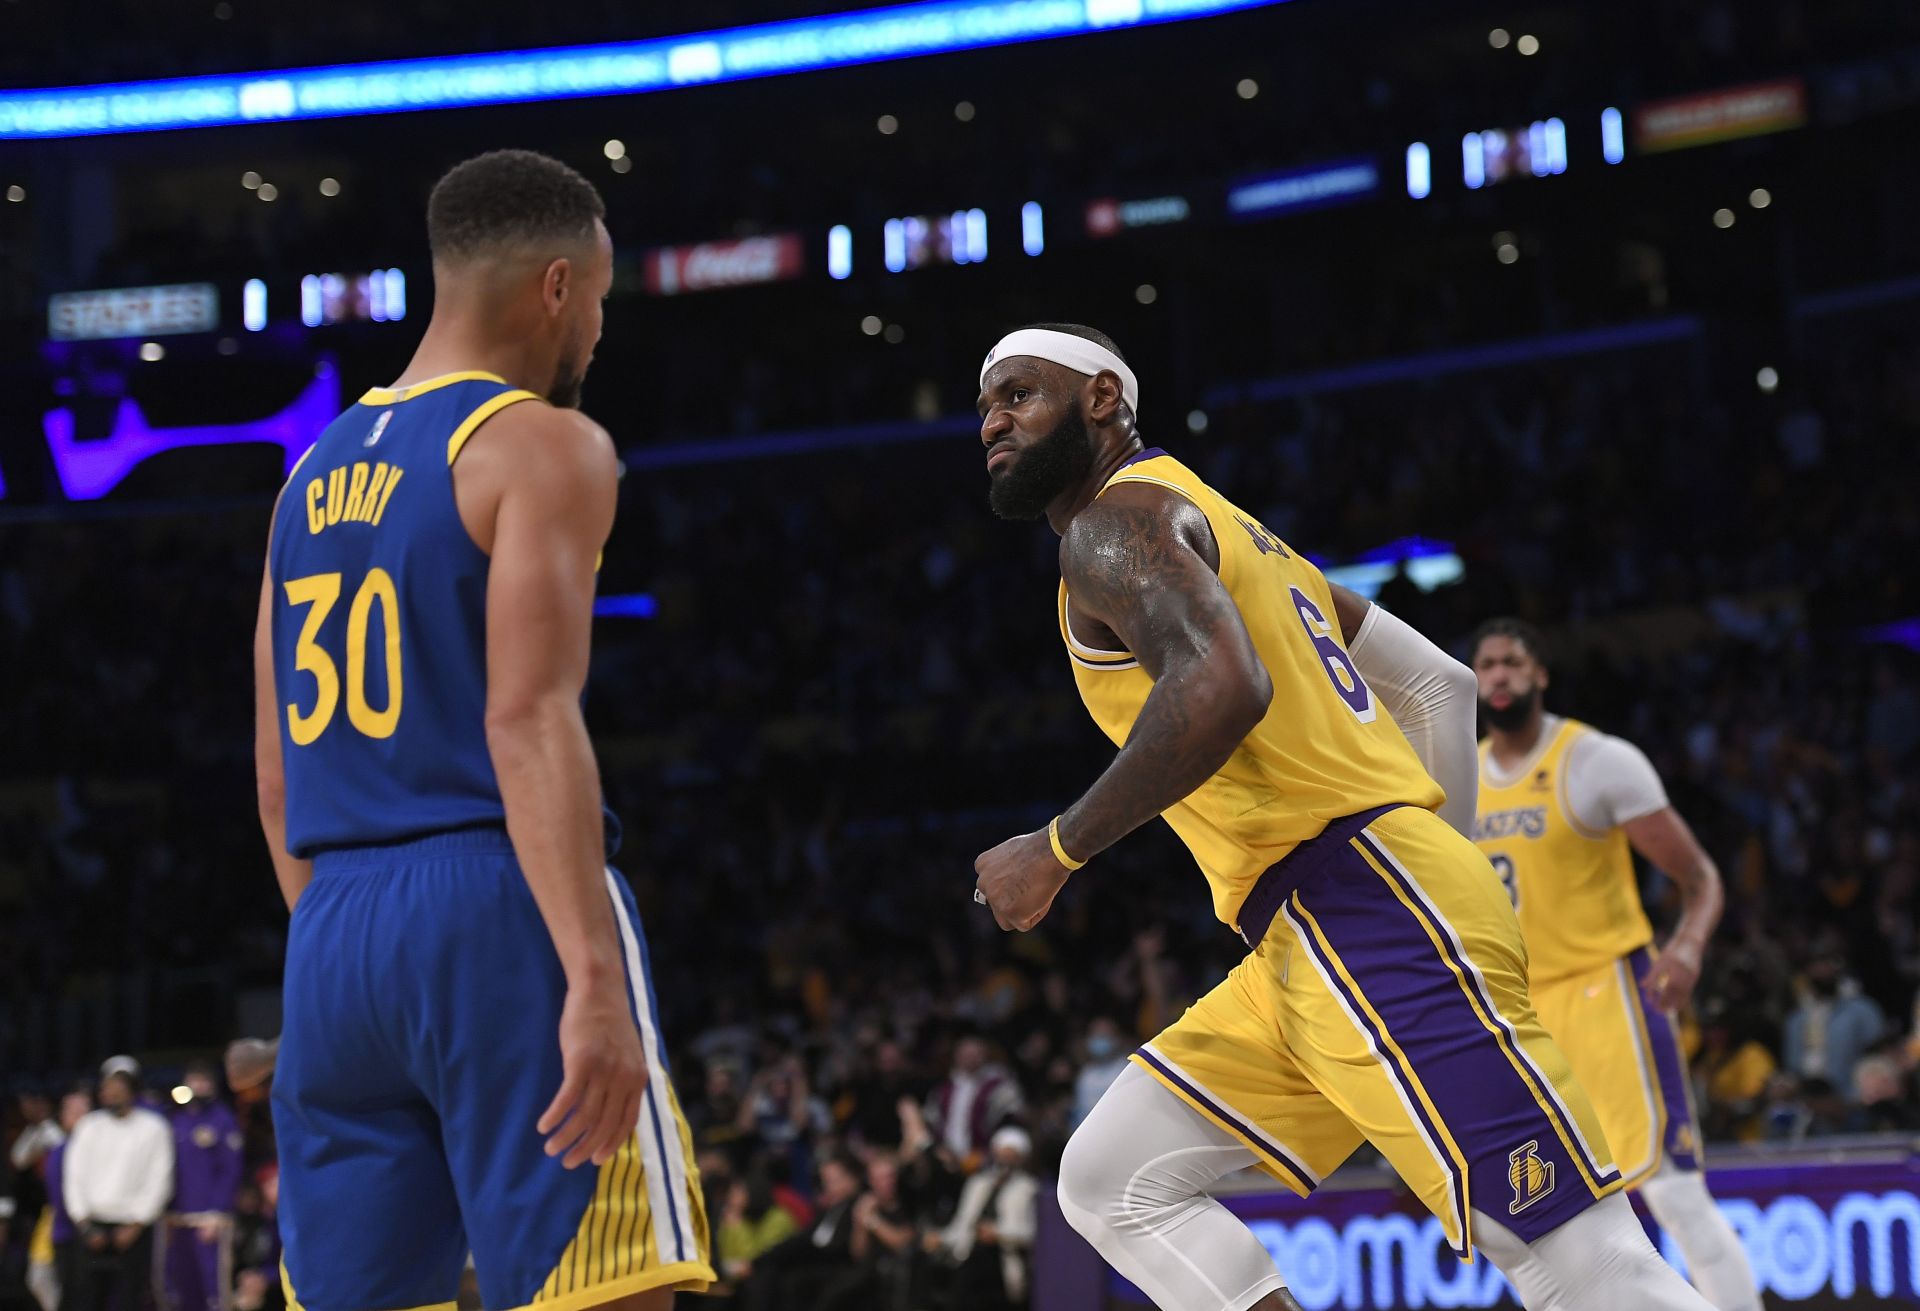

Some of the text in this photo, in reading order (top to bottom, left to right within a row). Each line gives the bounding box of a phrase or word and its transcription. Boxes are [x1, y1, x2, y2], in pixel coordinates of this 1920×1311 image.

[306, 462, 404, 535] CURRY
[283, 567, 403, 746] 30
[1289, 584, 1377, 724] 6
